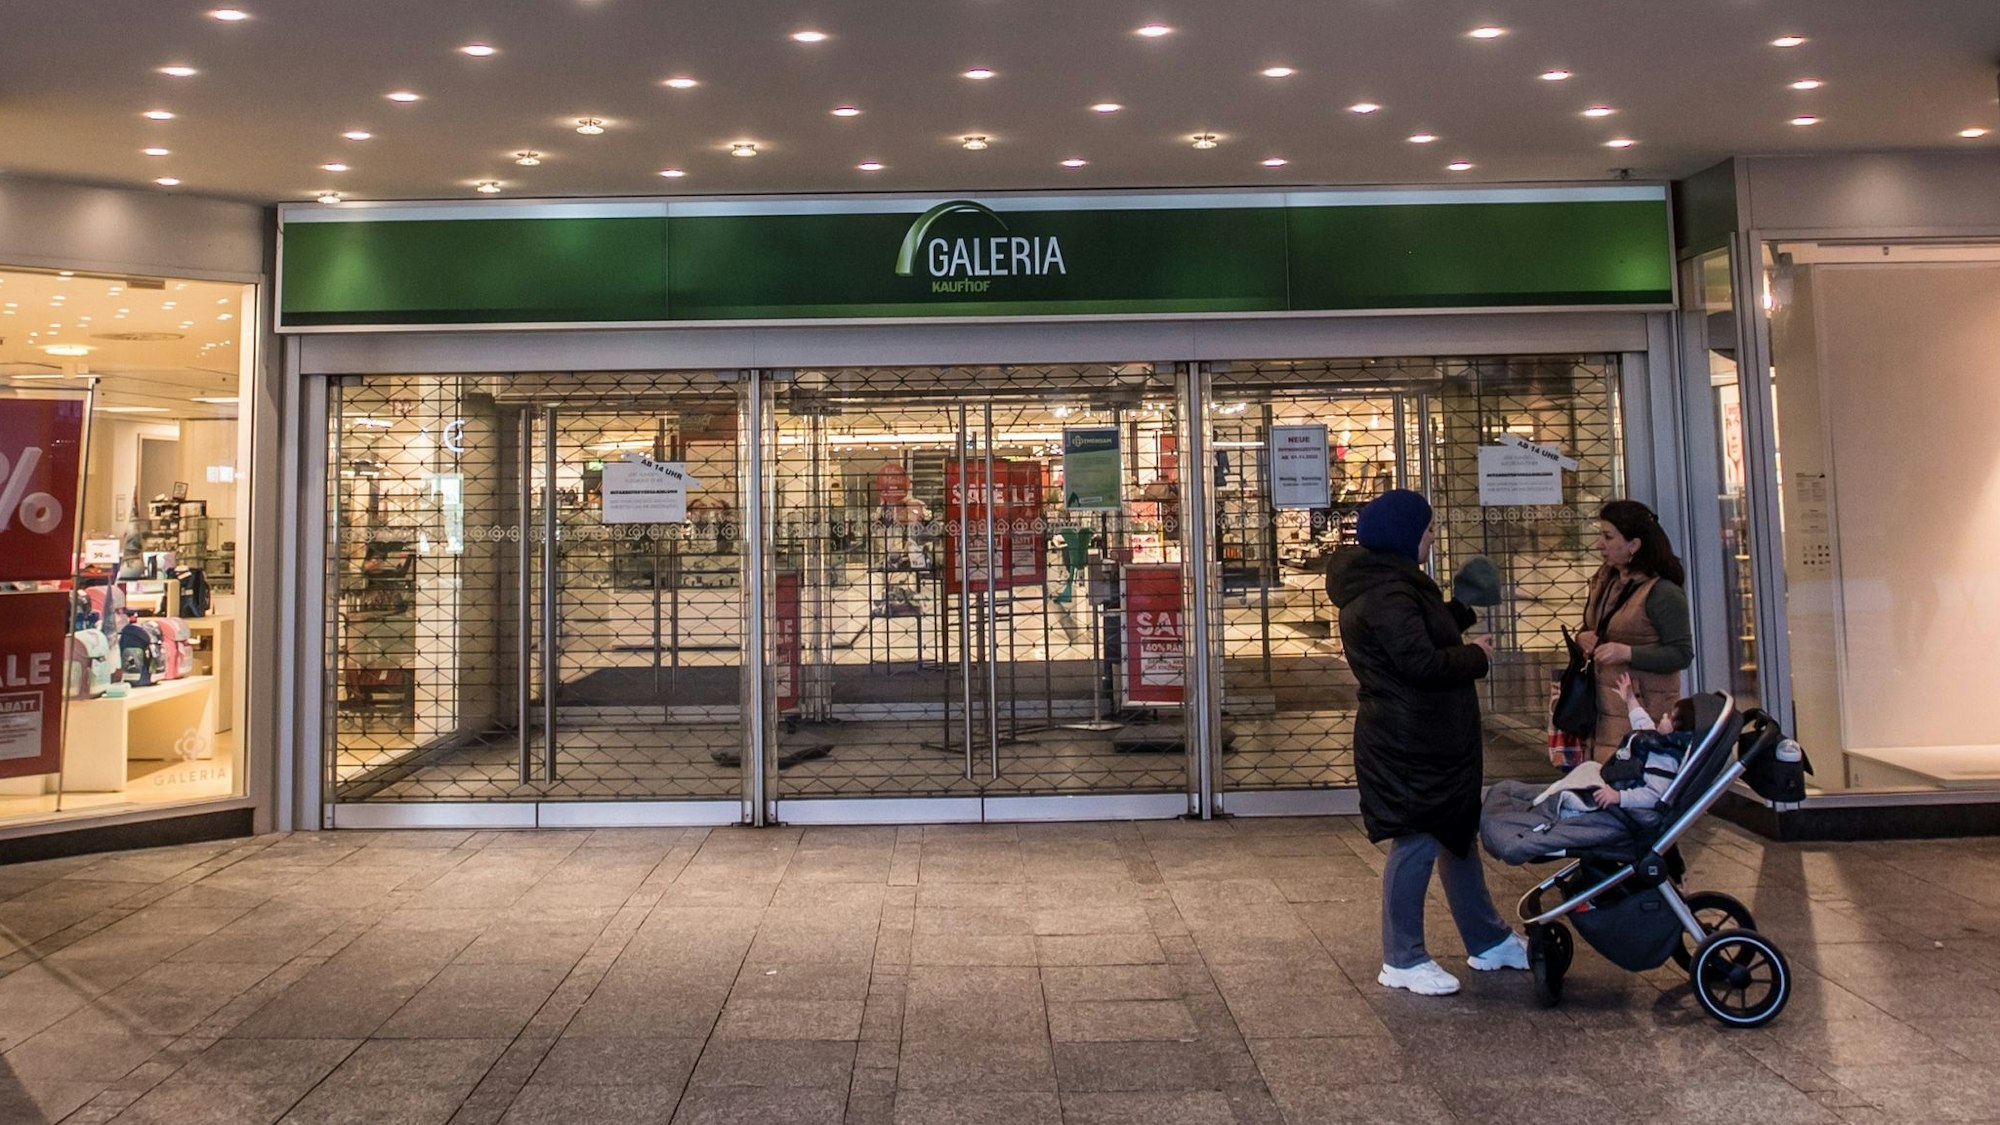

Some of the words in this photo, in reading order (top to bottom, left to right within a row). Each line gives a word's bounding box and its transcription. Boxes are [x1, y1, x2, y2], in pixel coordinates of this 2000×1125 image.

[928, 236, 1067, 277] GALERIA
[1517, 441, 1528, 449] AB
[1531, 446, 1540, 454] 14
[1541, 450, 1559, 461] UHR
[641, 459, 652, 468] AB
[655, 464, 664, 472] 14
[665, 468, 683, 480] UHR
[0, 652, 52, 688] LE
[153, 768, 226, 786] GALERIA
